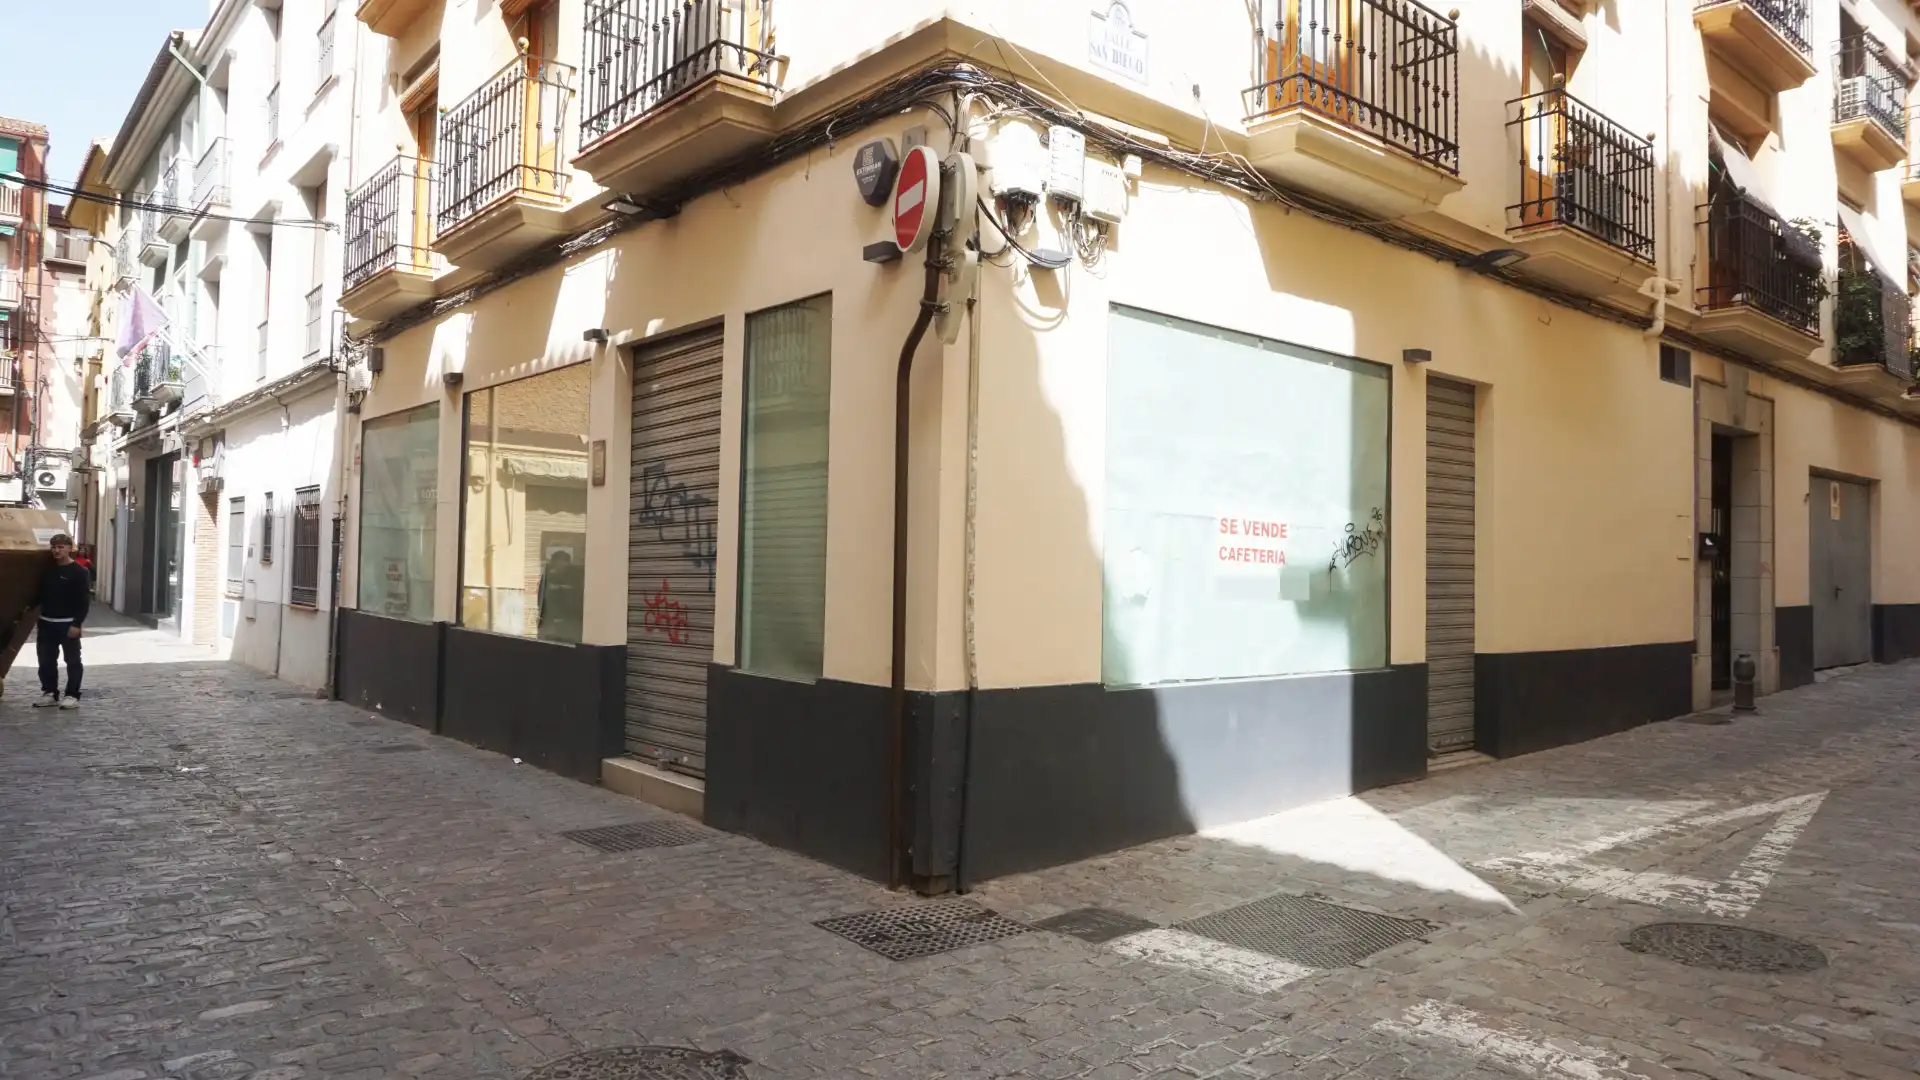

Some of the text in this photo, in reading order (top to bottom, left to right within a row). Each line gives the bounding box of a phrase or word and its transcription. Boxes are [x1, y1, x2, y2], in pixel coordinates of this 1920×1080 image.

[1090, 41, 1142, 74] SAN DIEGO
[1220, 518, 1287, 538] SE VENDE
[1219, 546, 1286, 565] CAFETERIA
